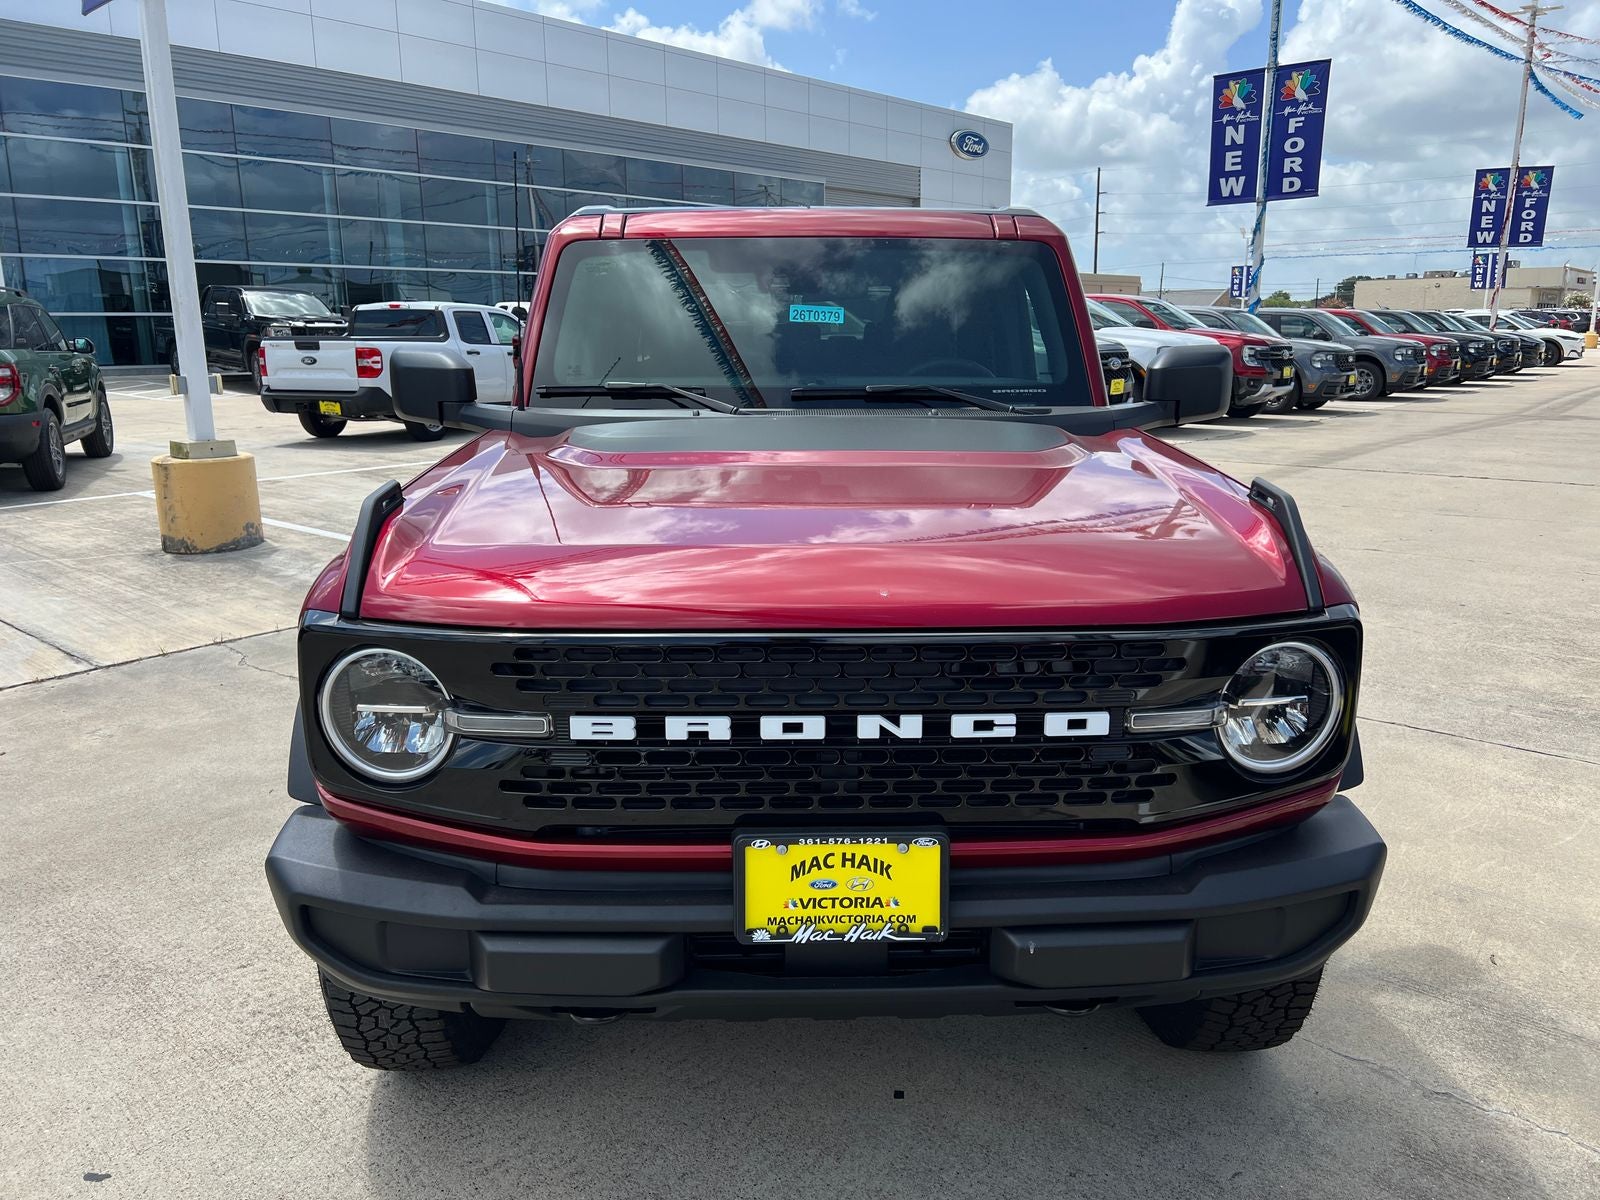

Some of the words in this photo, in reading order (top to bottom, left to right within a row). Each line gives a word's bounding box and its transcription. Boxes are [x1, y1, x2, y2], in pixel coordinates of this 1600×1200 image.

[963, 135, 984, 154] Ford
[1282, 117, 1305, 193] FORD
[1220, 124, 1246, 197] NEW
[1476, 201, 1496, 243] NEW
[1519, 198, 1537, 243] FORD
[1232, 278, 1240, 296] NEW
[1474, 267, 1483, 288] NEW
[792, 309, 841, 322] 26T0379
[569, 711, 1111, 740] BRONCO
[798, 837, 888, 845] 361-576-1221
[791, 852, 835, 881] MAC
[841, 852, 893, 880] HAIK
[813, 879, 833, 889] Ford
[799, 896, 885, 909] VICTORIA
[767, 914, 917, 926] MACHAIKVICTORIA.COM
[785, 923, 842, 944] Mac
[843, 923, 906, 942] Haik
